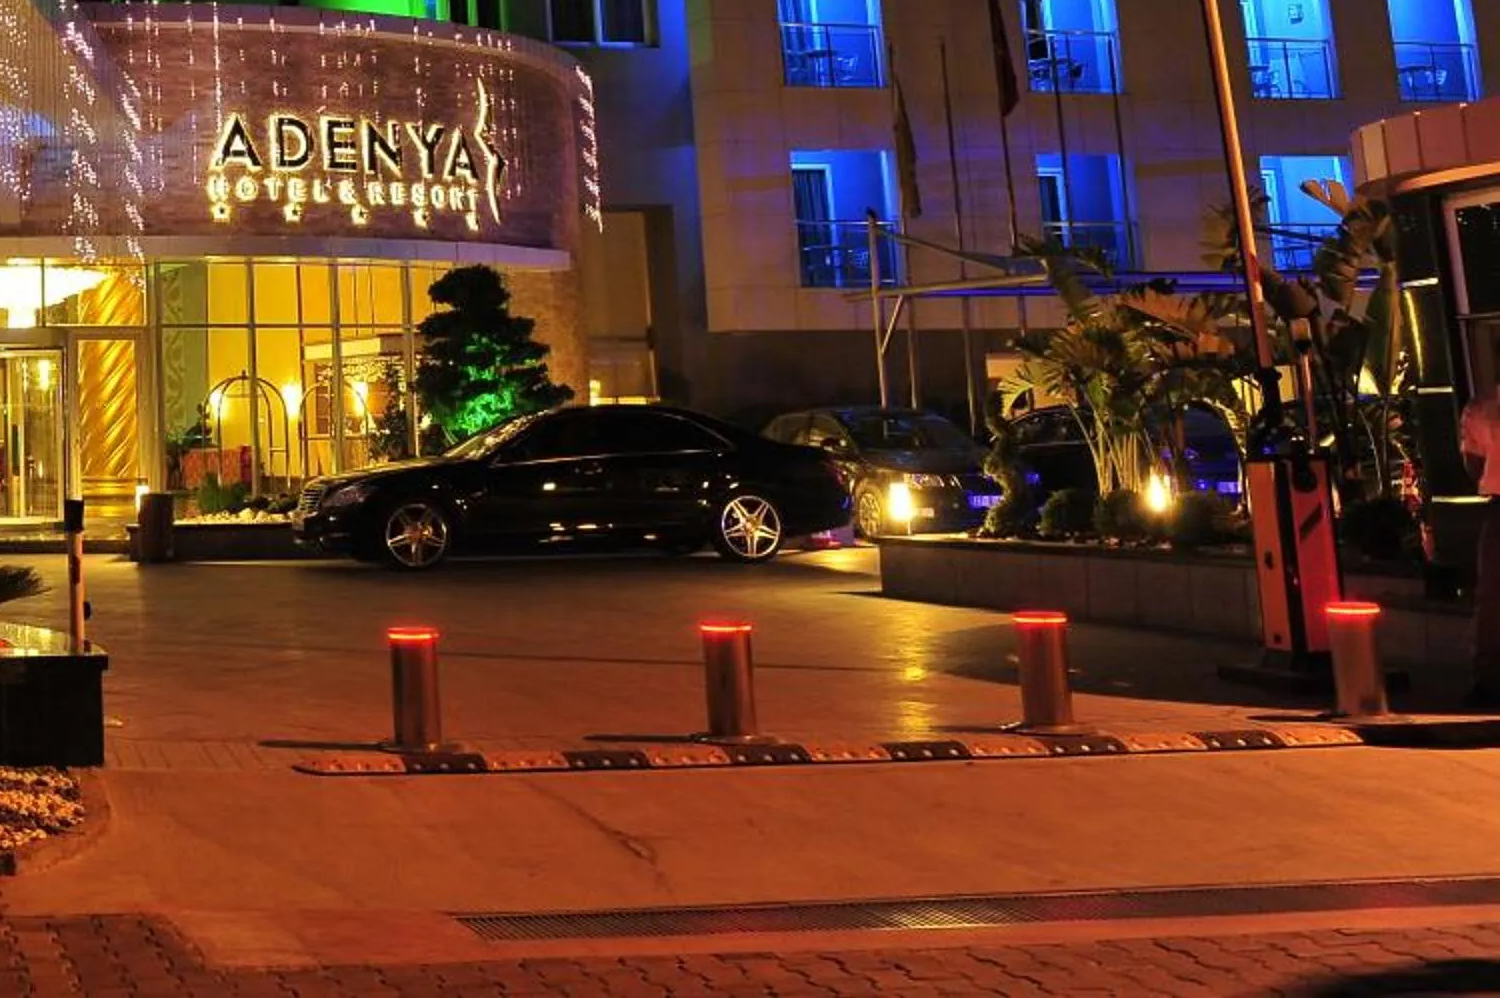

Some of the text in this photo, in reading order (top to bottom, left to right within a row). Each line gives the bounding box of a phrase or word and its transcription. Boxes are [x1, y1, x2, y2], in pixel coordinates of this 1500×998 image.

[210, 112, 479, 182] ADENYA
[207, 176, 330, 202] HOTEL
[367, 181, 479, 212] RESORT
